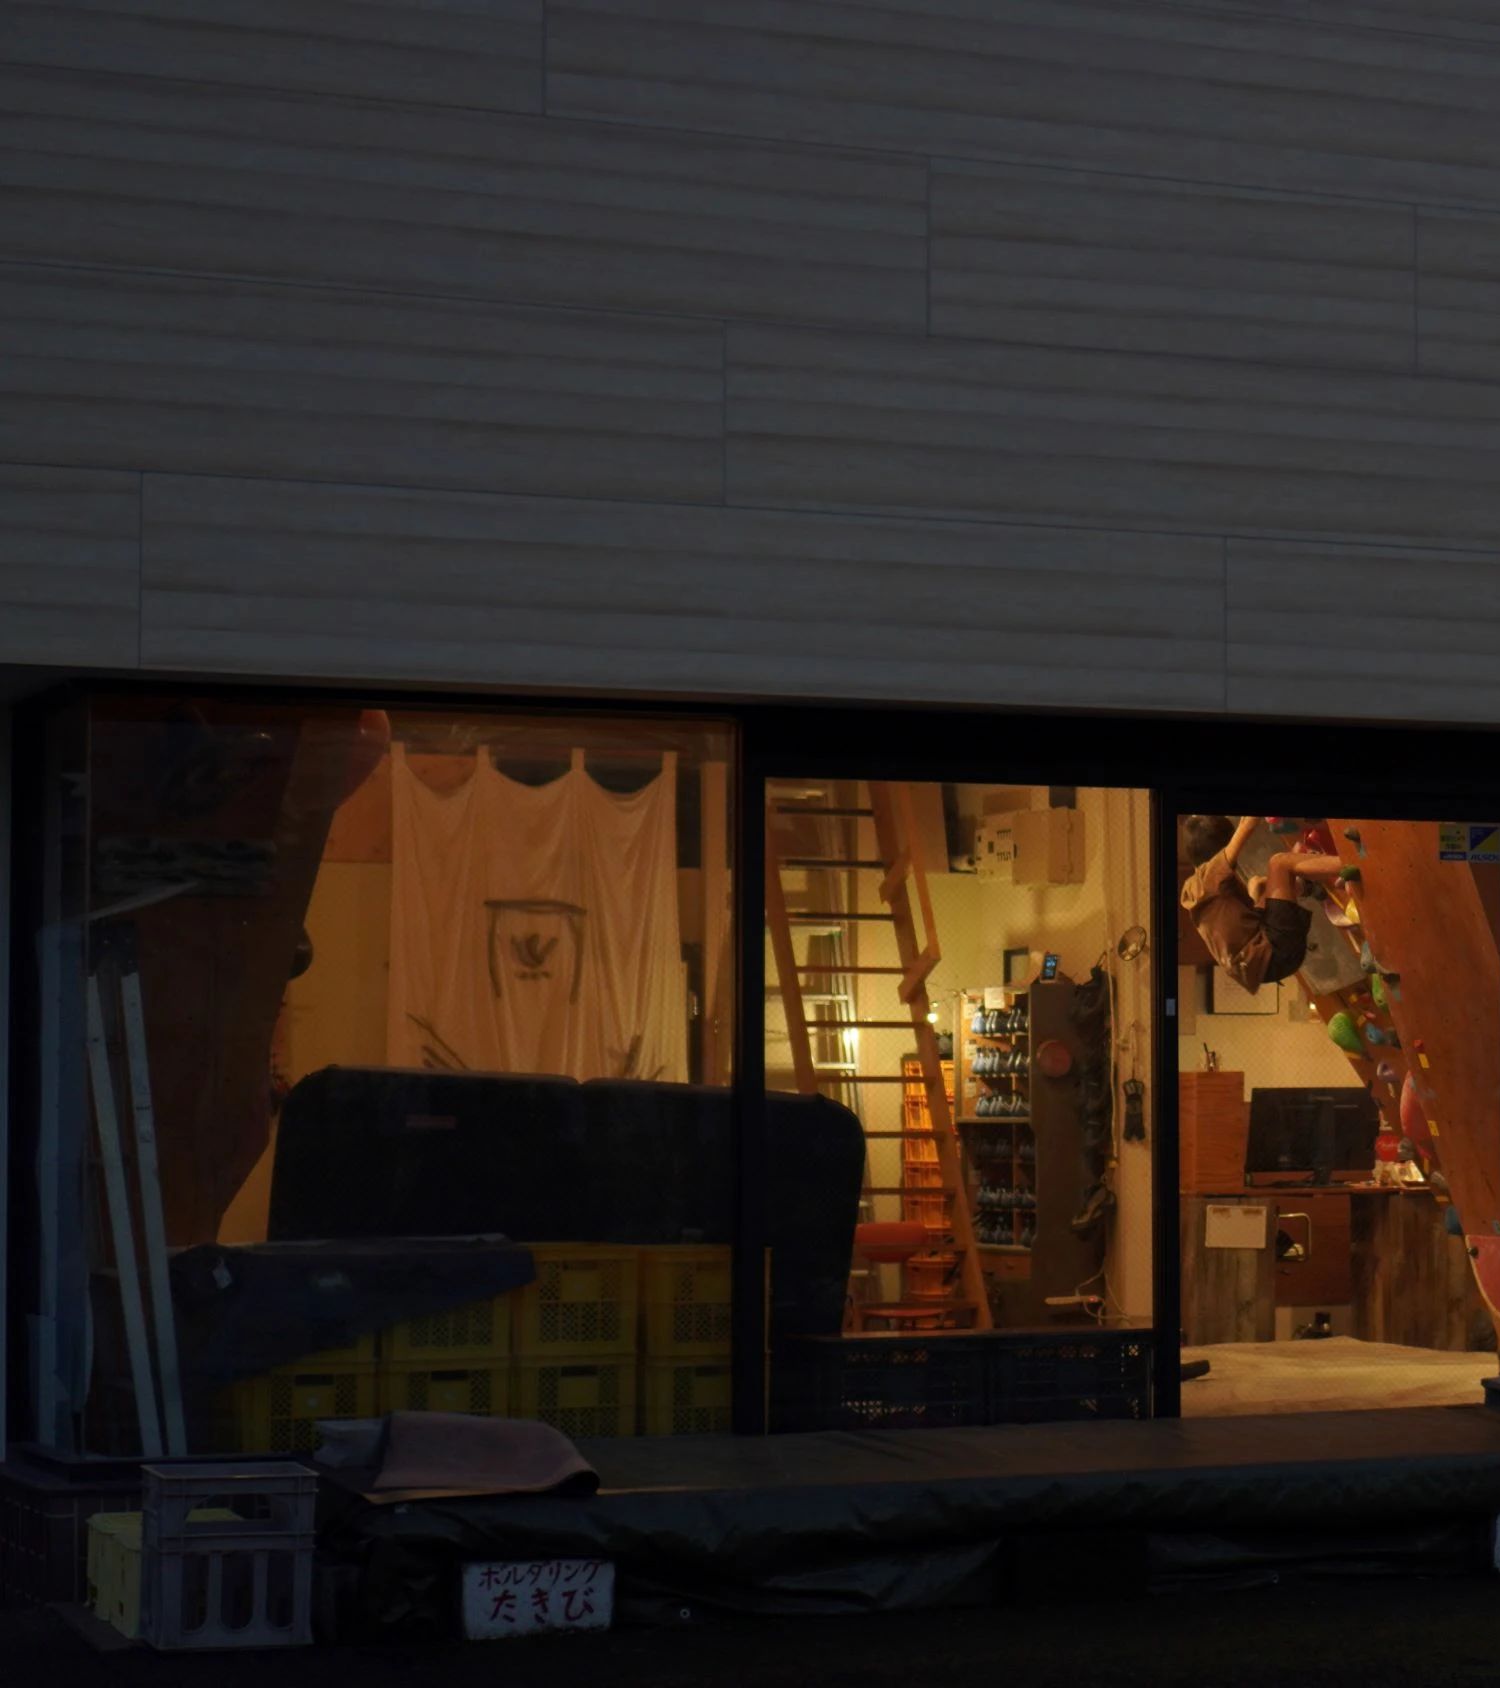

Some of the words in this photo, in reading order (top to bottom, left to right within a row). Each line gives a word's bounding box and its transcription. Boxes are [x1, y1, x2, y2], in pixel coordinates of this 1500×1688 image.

[478, 1559, 604, 1590] ボルダリング
[490, 1587, 594, 1624] たきび
